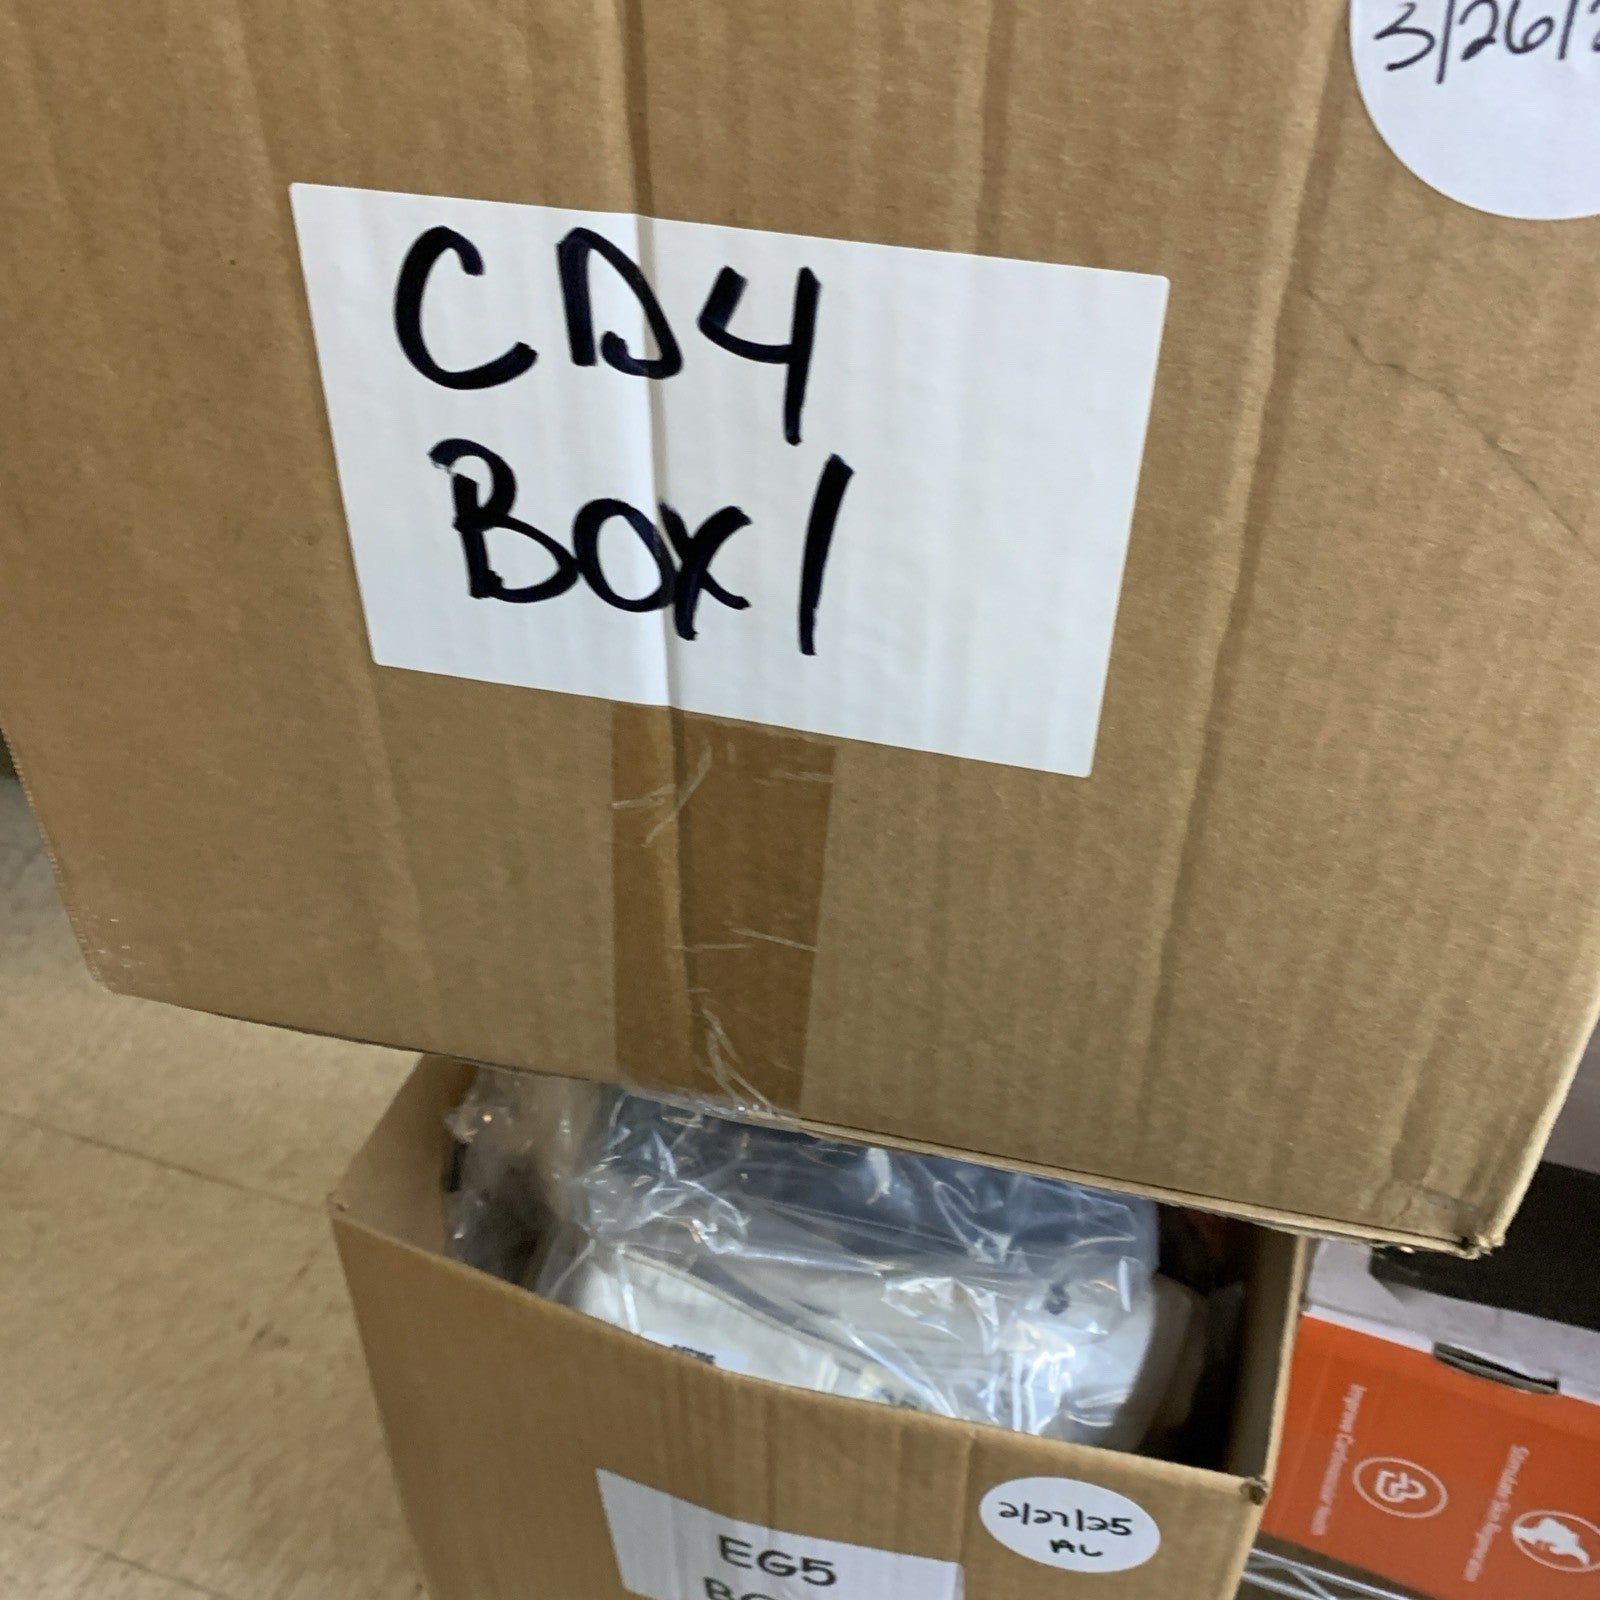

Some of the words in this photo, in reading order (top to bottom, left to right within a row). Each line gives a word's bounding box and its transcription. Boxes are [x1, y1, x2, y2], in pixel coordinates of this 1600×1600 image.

[799, 453, 854, 656] 1
[998, 1501, 1134, 1537] 2/27/25
[718, 1534, 837, 1587] EG5
